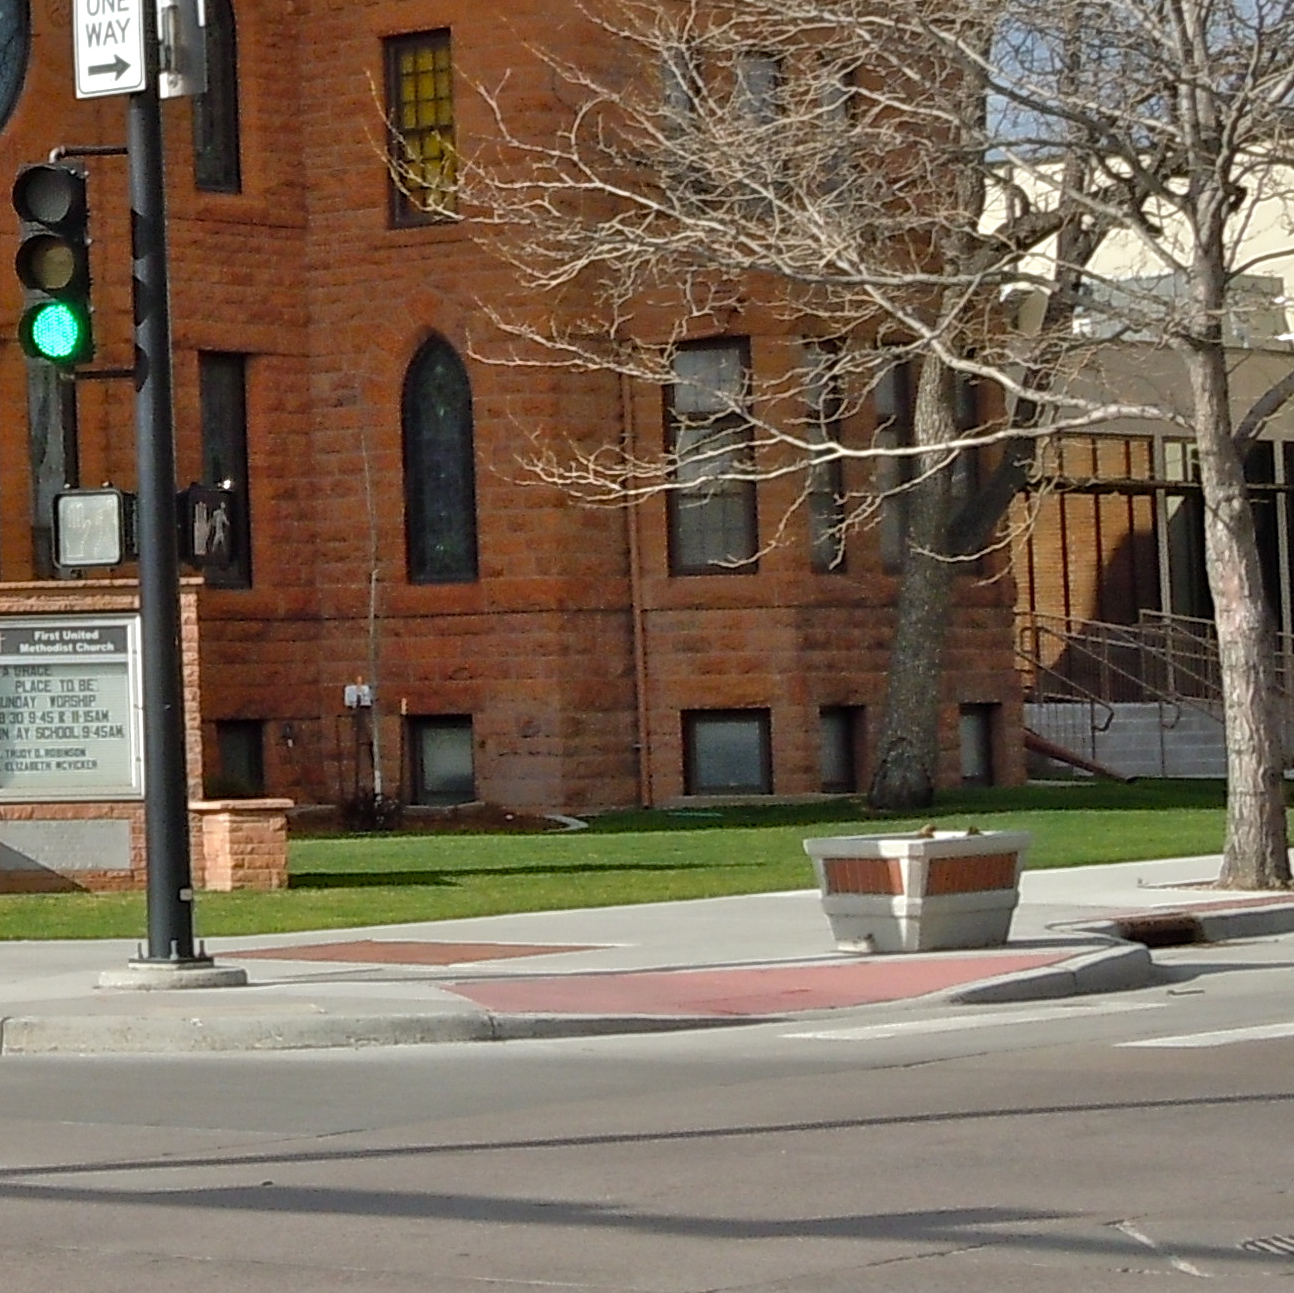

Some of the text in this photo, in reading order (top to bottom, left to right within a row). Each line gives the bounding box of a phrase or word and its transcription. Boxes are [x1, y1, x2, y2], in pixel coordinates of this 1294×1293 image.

[85, 17, 131, 48] WAY
[33, 629, 100, 641] First United
[19, 642, 115, 653] Methodist Church
[15, 679, 52, 693] PLACE
[59, 679, 75, 692] TO
[49, 695, 96, 708] WORSHIP
[35, 726, 79, 739] SCHOOL
